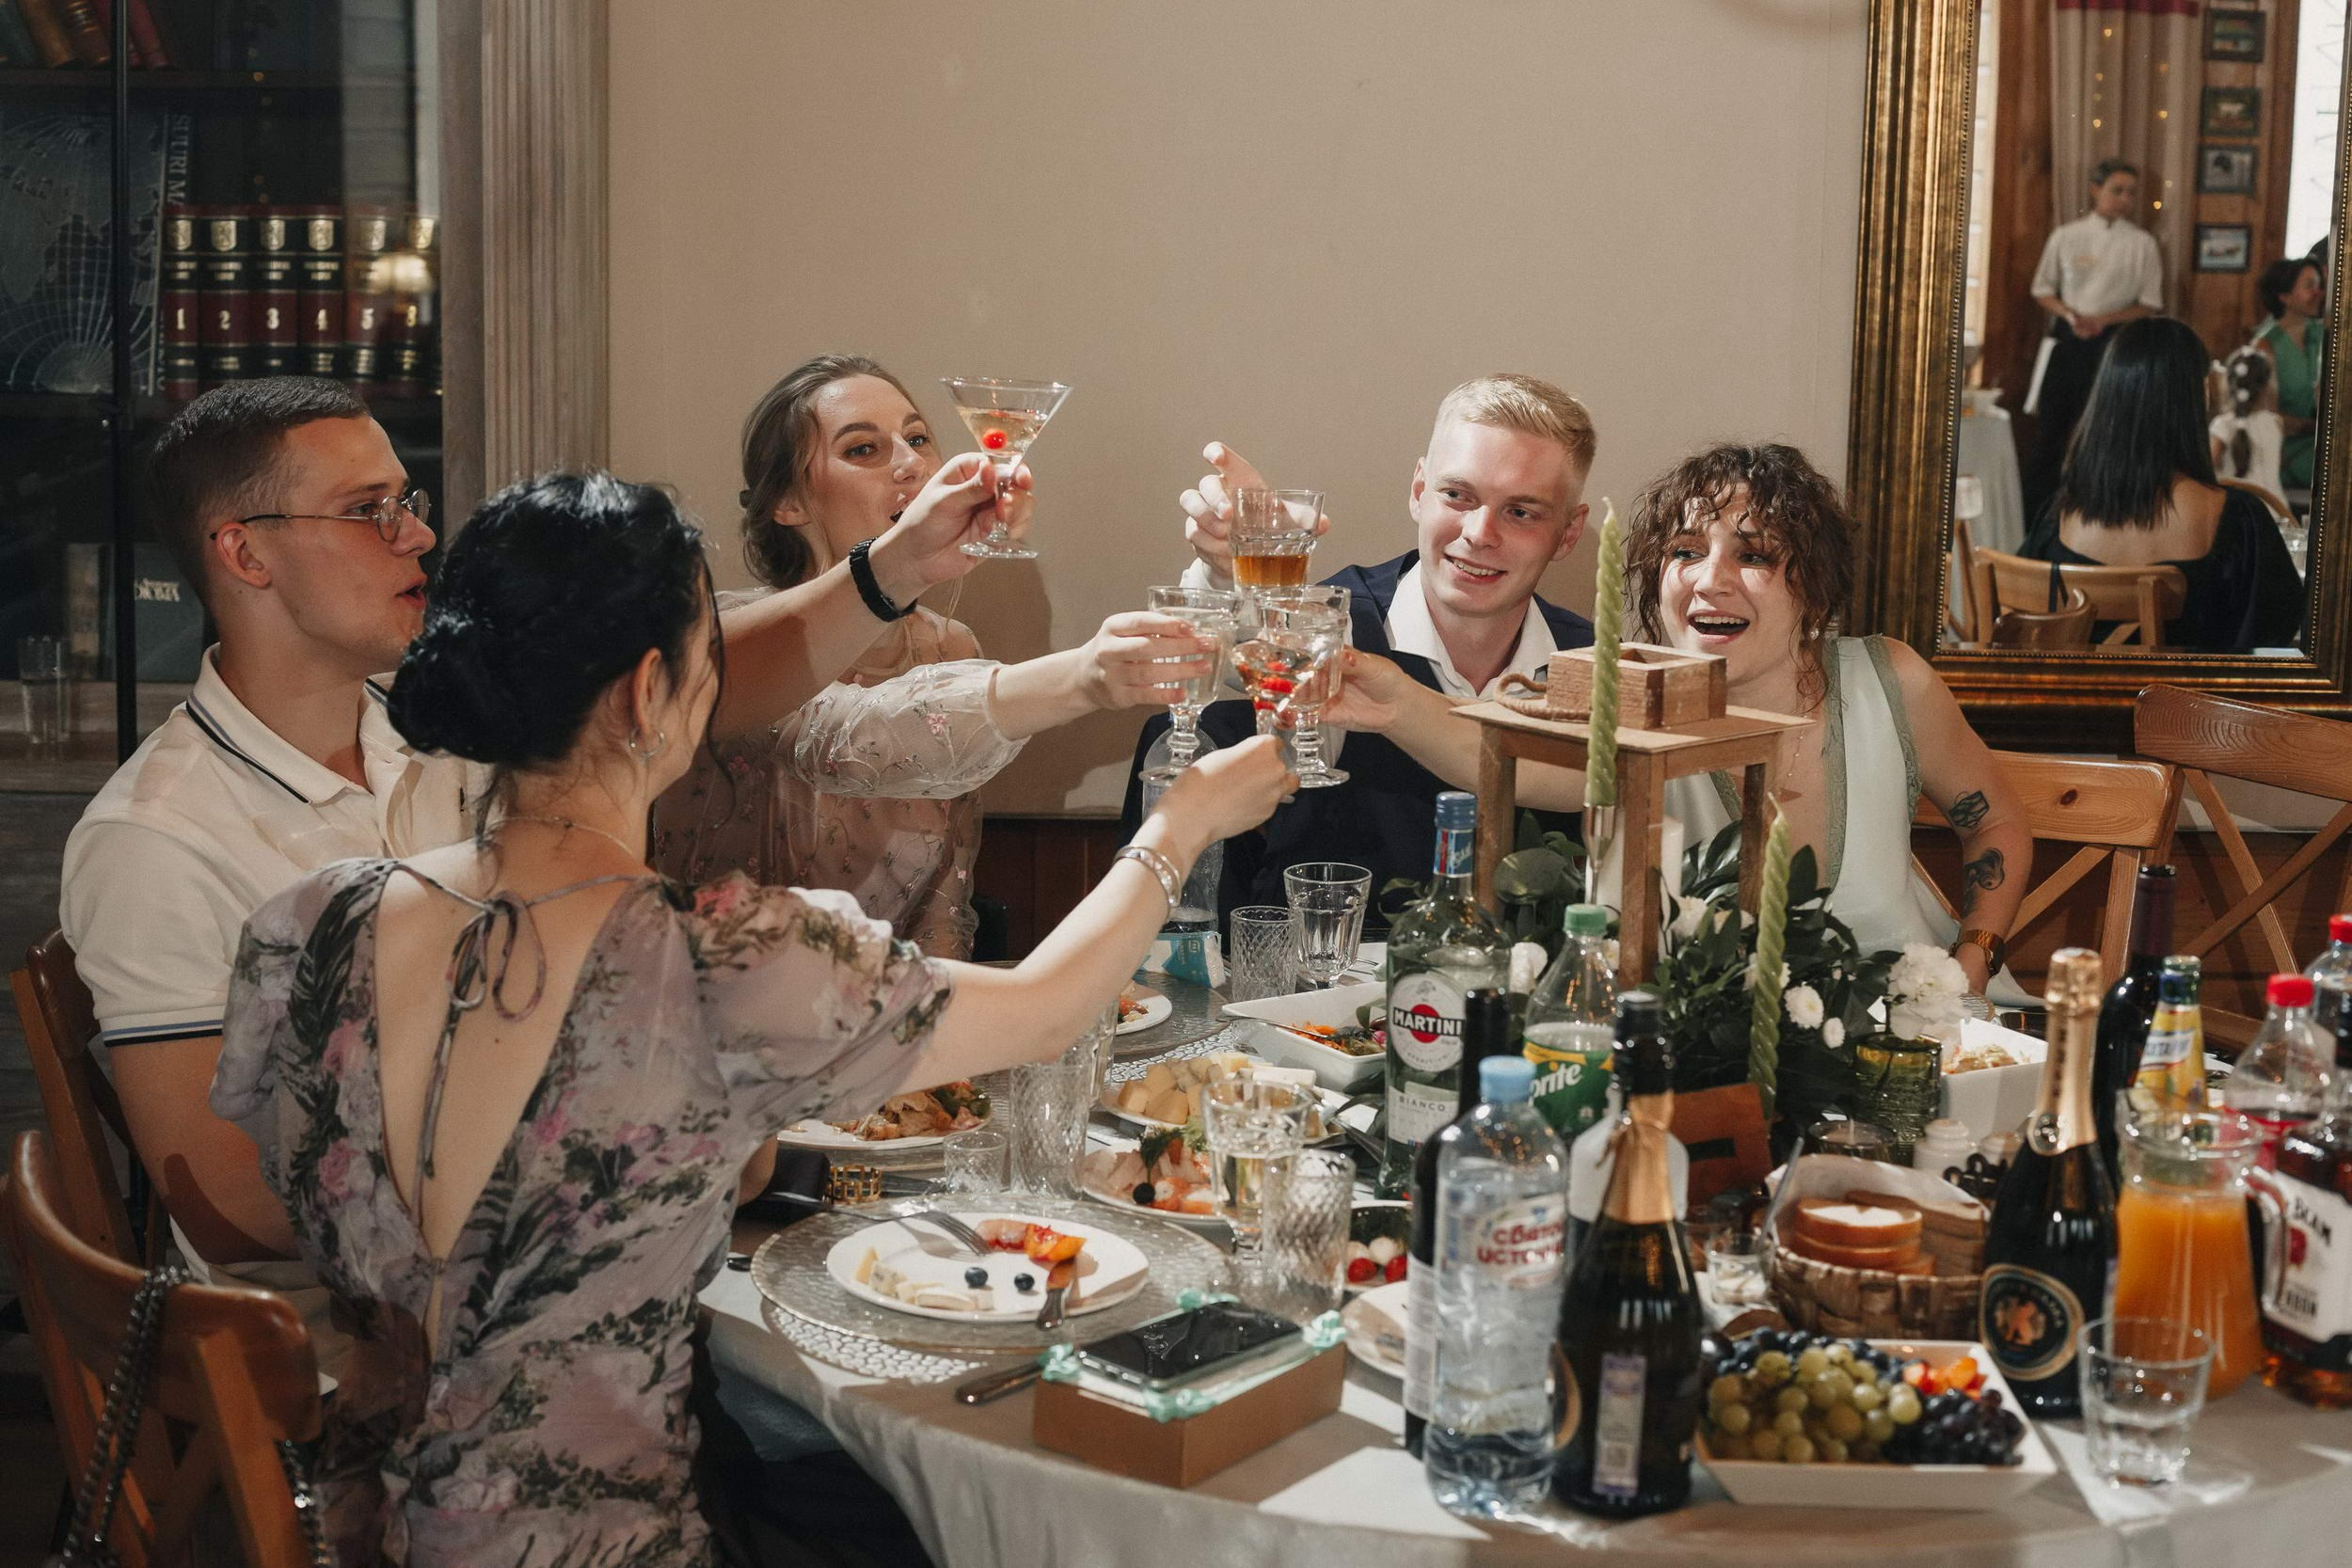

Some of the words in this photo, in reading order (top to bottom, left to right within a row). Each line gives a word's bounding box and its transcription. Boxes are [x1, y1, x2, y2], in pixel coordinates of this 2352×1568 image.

[176, 308, 186, 329] 1
[219, 309, 231, 329] 2
[266, 307, 280, 329] 3
[316, 309, 328, 330] 4
[360, 308, 374, 329] 5
[1393, 1009, 1463, 1036] MARTINI
[1528, 1060, 1584, 1108] prite
[1399, 1096, 1446, 1112] BIANCO
